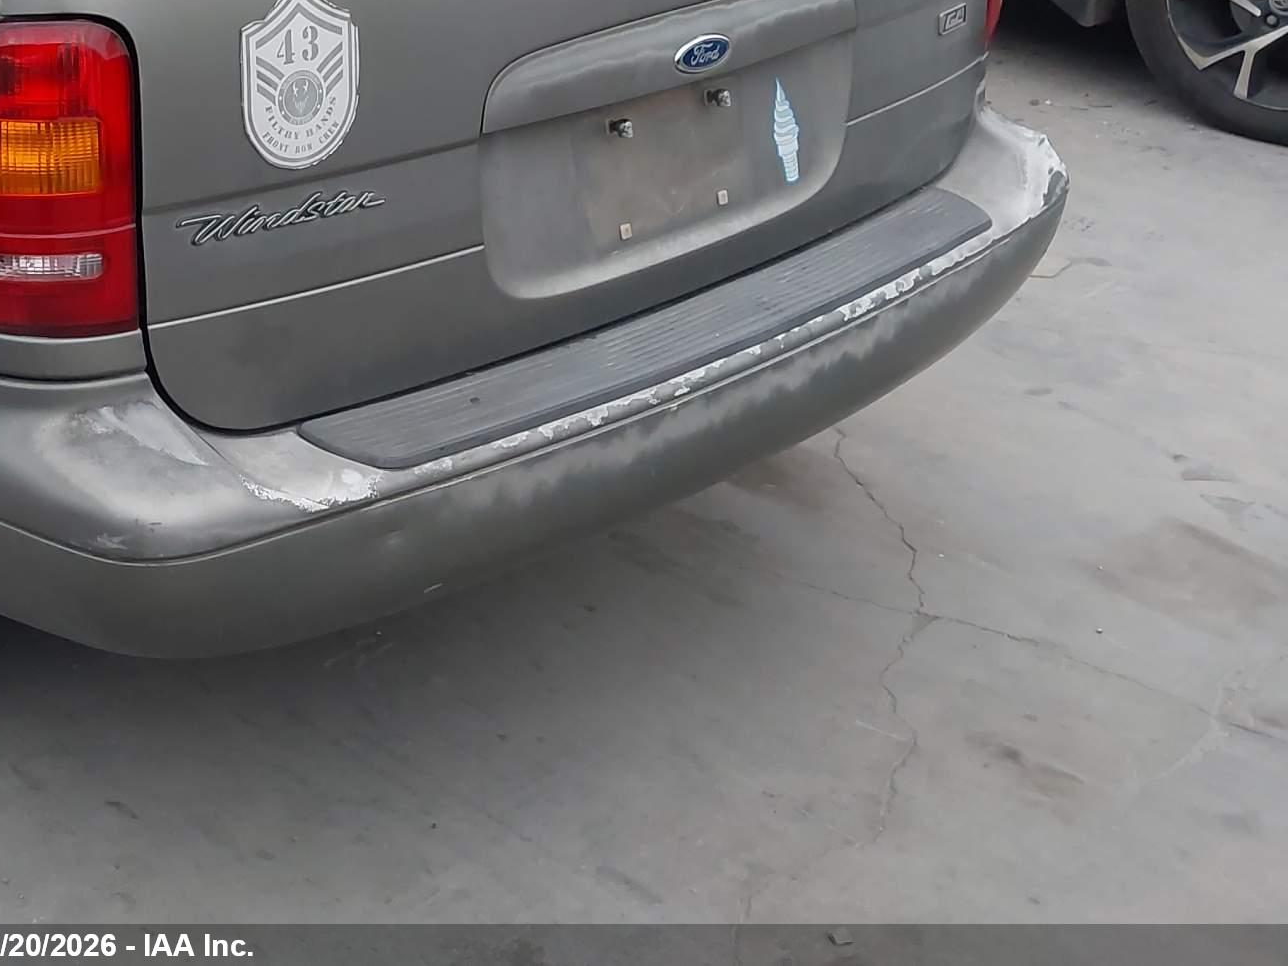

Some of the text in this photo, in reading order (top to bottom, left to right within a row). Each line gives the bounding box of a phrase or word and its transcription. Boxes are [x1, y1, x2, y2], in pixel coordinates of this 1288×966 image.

[276, 25, 320, 65] 43
[690, 42, 721, 66] Ford
[262, 131, 288, 152] FRONT
[176, 191, 387, 245] Windstar
